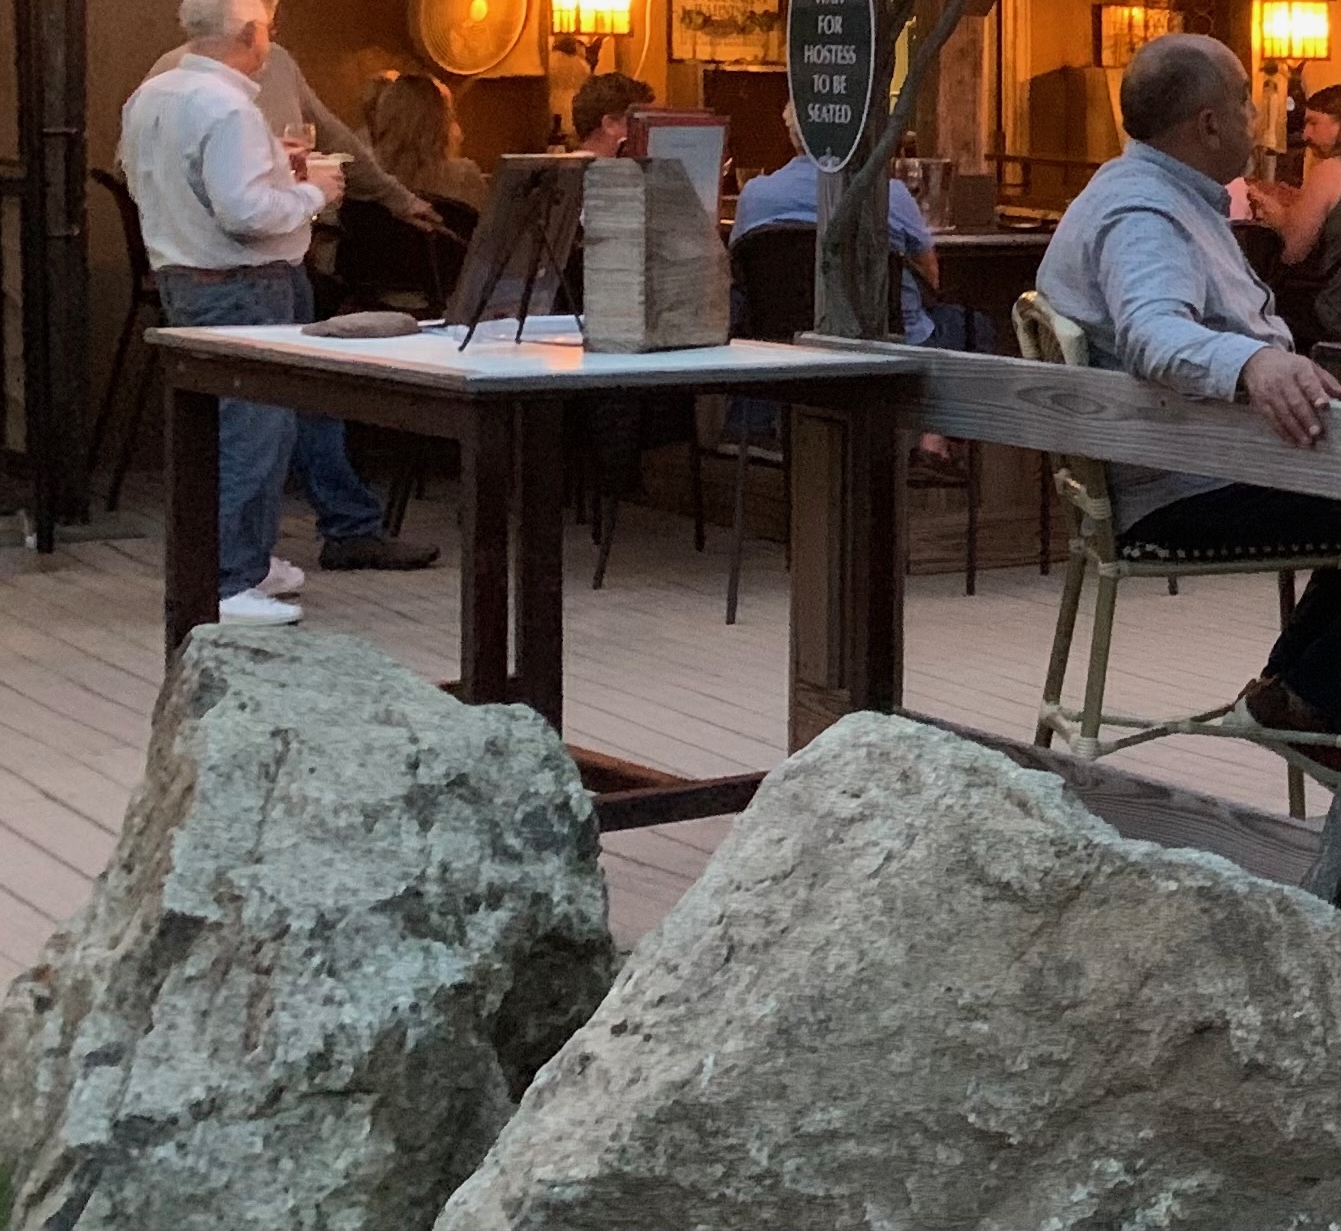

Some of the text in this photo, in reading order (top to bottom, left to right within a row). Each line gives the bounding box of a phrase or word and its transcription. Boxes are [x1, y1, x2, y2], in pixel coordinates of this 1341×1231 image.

[818, 15, 843, 35] FOR
[804, 44, 857, 65] HOSTESS
[812, 74, 847, 94] TO BE
[808, 103, 851, 123] SEATED
